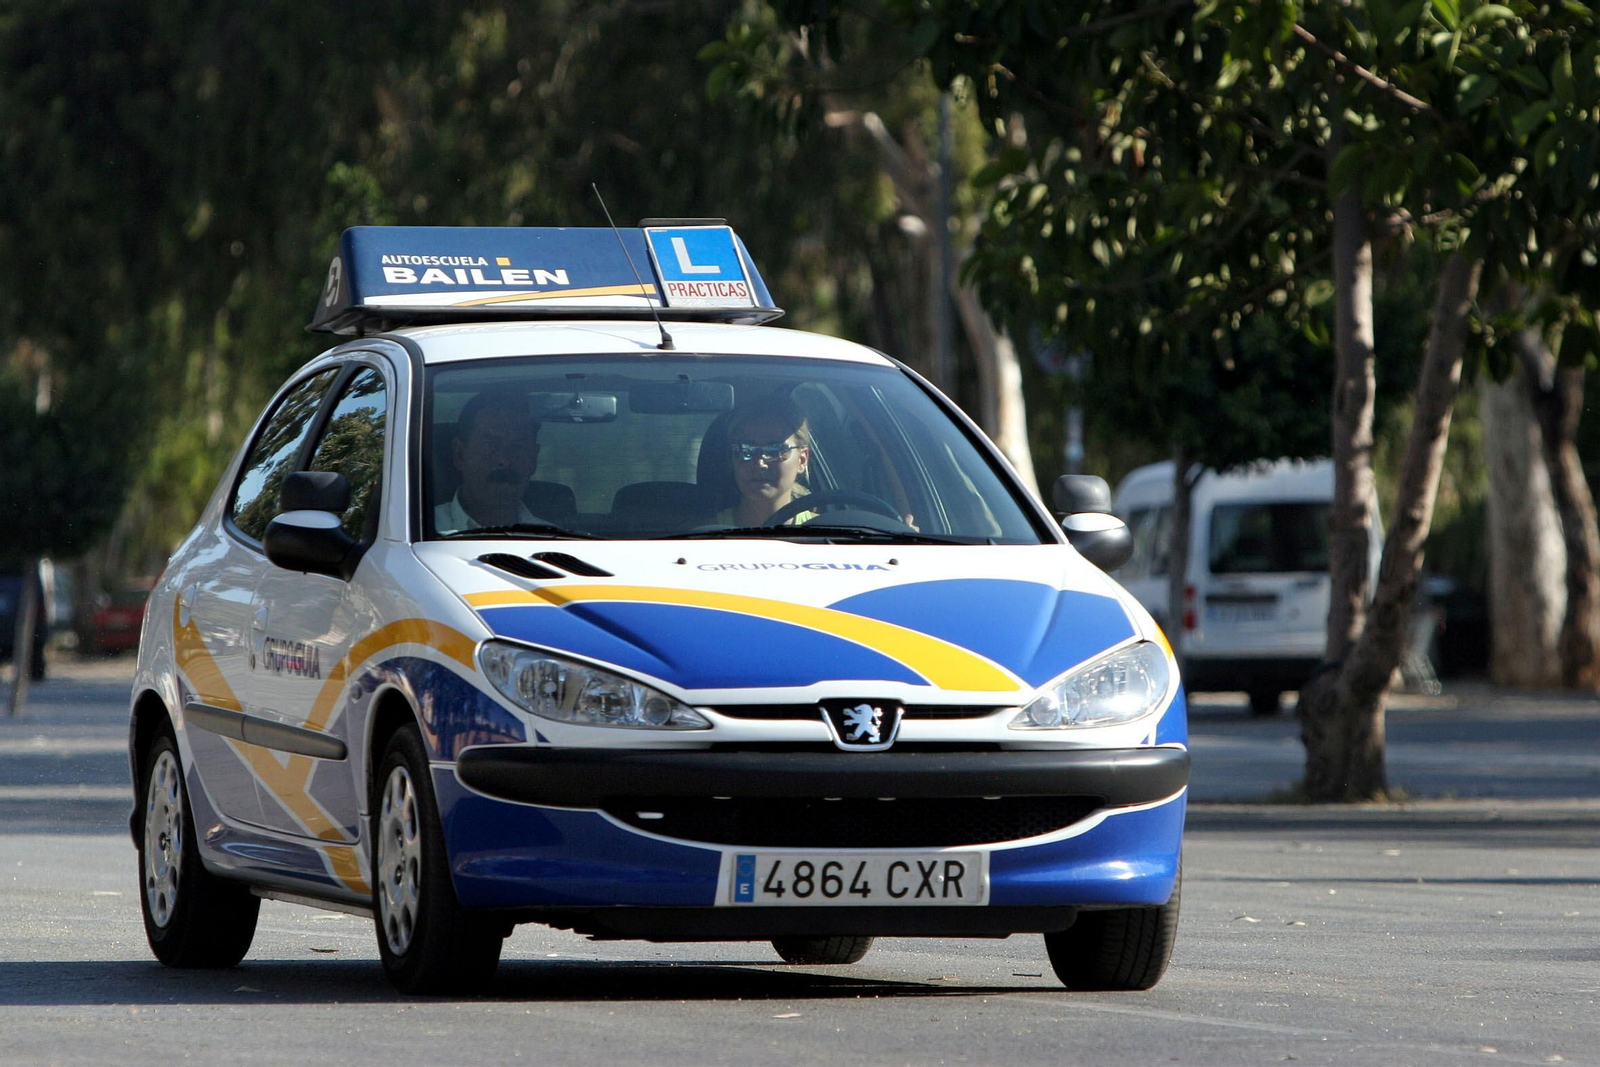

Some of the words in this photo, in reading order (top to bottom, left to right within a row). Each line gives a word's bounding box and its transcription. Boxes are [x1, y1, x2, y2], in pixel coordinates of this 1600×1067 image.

[381, 254, 489, 267] AUTOESCUELA
[670, 237, 721, 274] L
[382, 266, 570, 285] BAILEN
[667, 282, 748, 297] PRACTICAS
[763, 860, 872, 899] 4864
[886, 860, 966, 899] CXR
[739, 883, 750, 895] E
